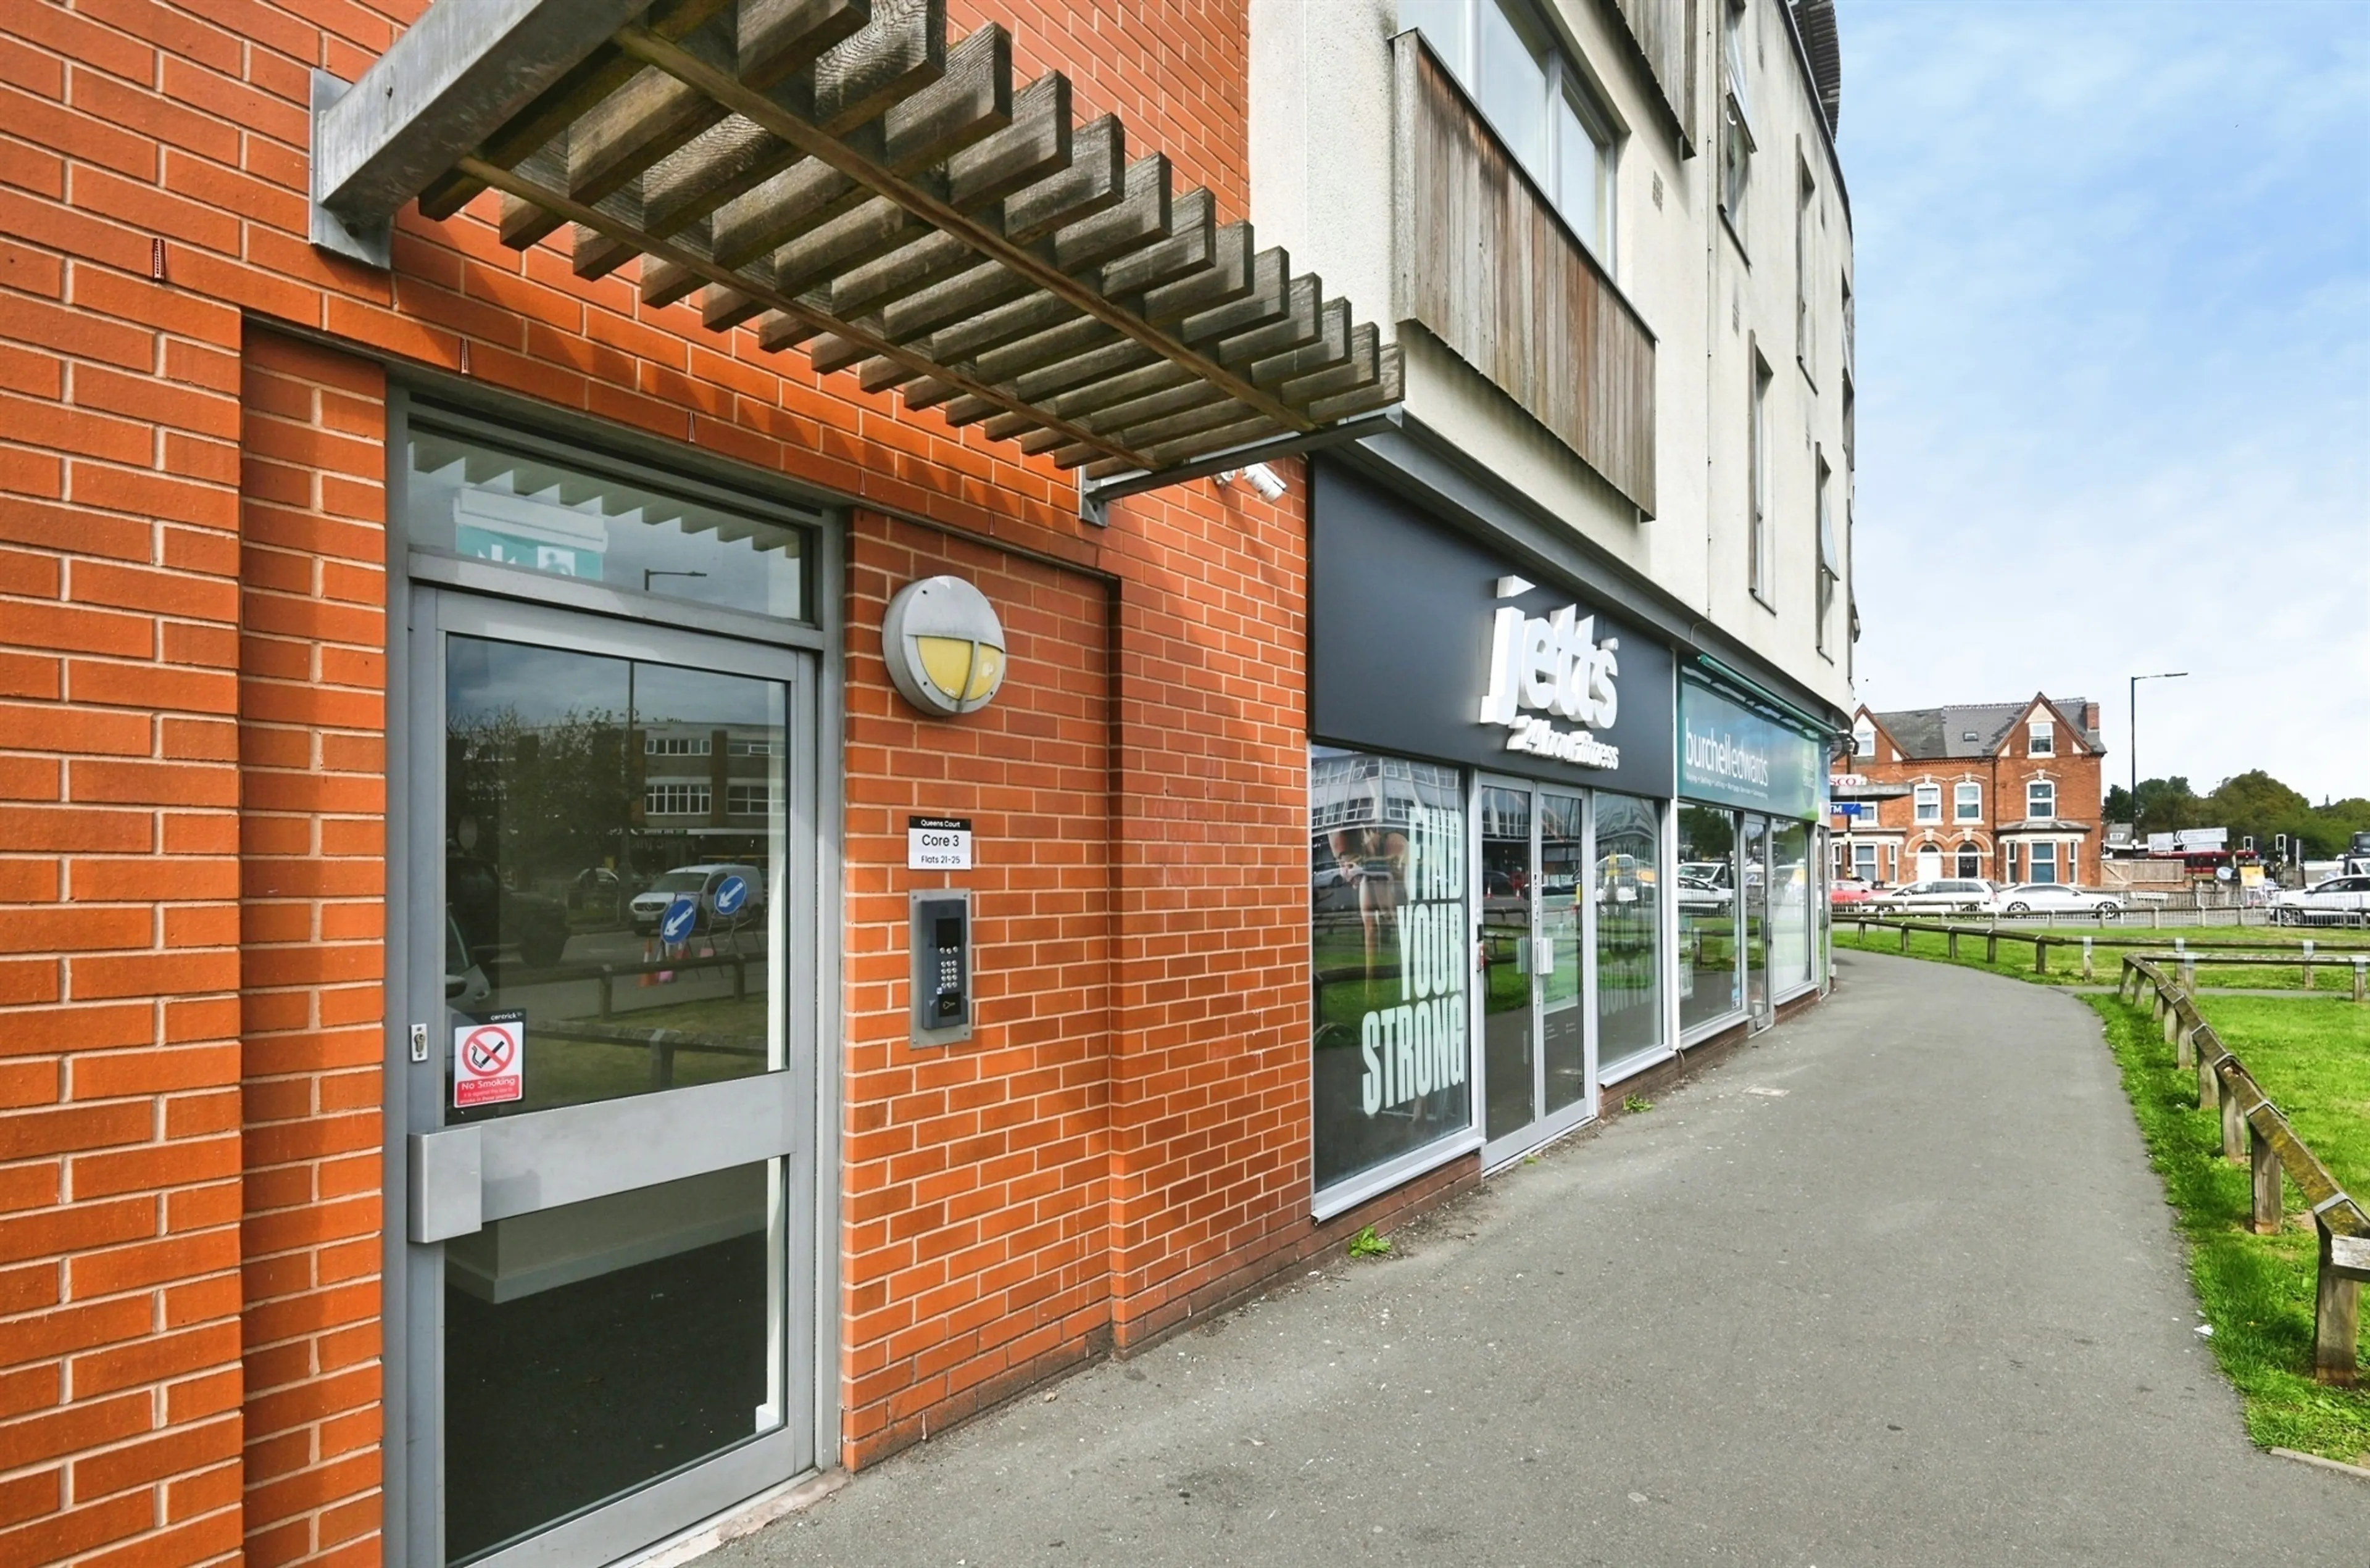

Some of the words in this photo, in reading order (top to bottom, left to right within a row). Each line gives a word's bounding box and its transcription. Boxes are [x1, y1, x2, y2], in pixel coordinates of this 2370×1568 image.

[921, 819, 943, 827] Queens
[921, 834, 950, 846] Core
[952, 834, 959, 847] 3
[921, 855, 939, 864] Flats
[941, 855, 960, 864] 21-25
[1408, 807, 1463, 900] FIND
[1396, 903, 1463, 1001] YOUR
[1362, 994, 1465, 1116] STRONG
[461, 1082, 475, 1090] No
[477, 1077, 515, 1089] Smoking
